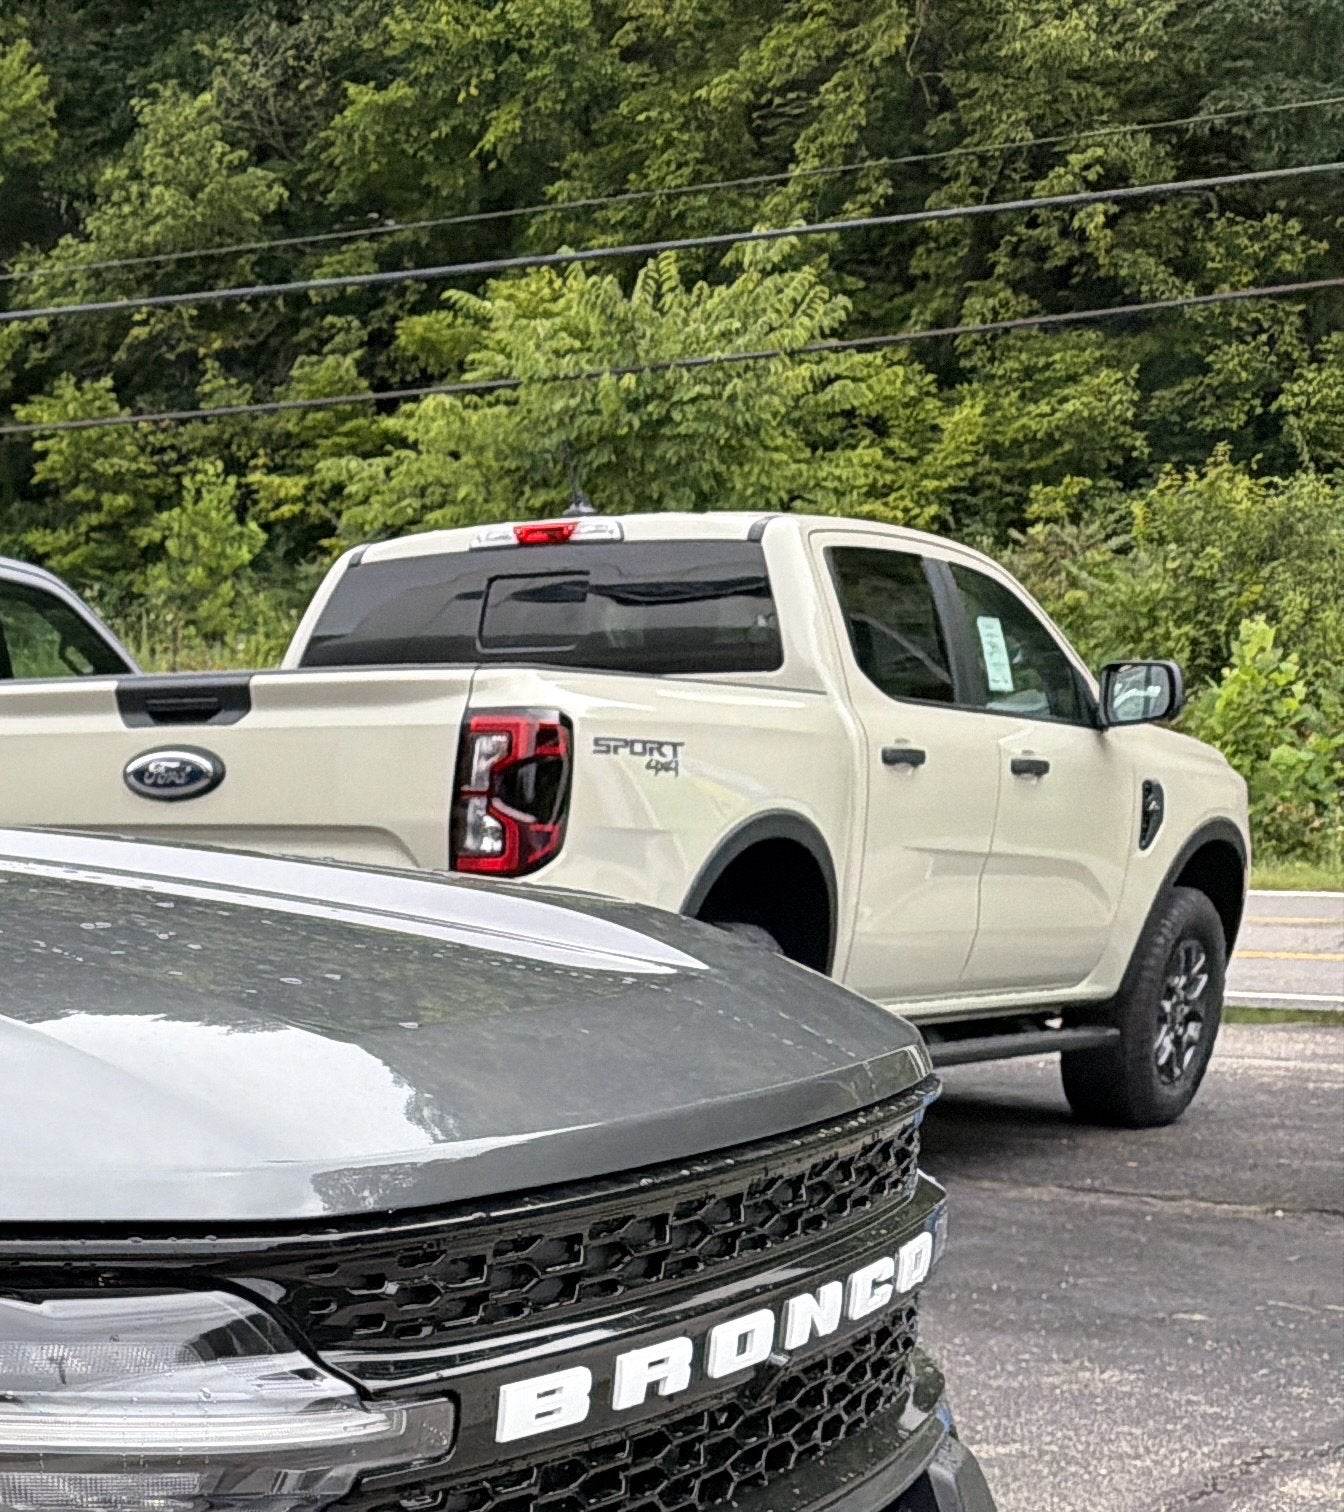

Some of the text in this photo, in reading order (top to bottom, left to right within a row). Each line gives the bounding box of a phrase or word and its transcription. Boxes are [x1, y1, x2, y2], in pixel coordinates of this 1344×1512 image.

[592, 736, 685, 759] SPORT
[143, 760, 193, 785] Ford
[494, 1231, 934, 1444] BRONCO
